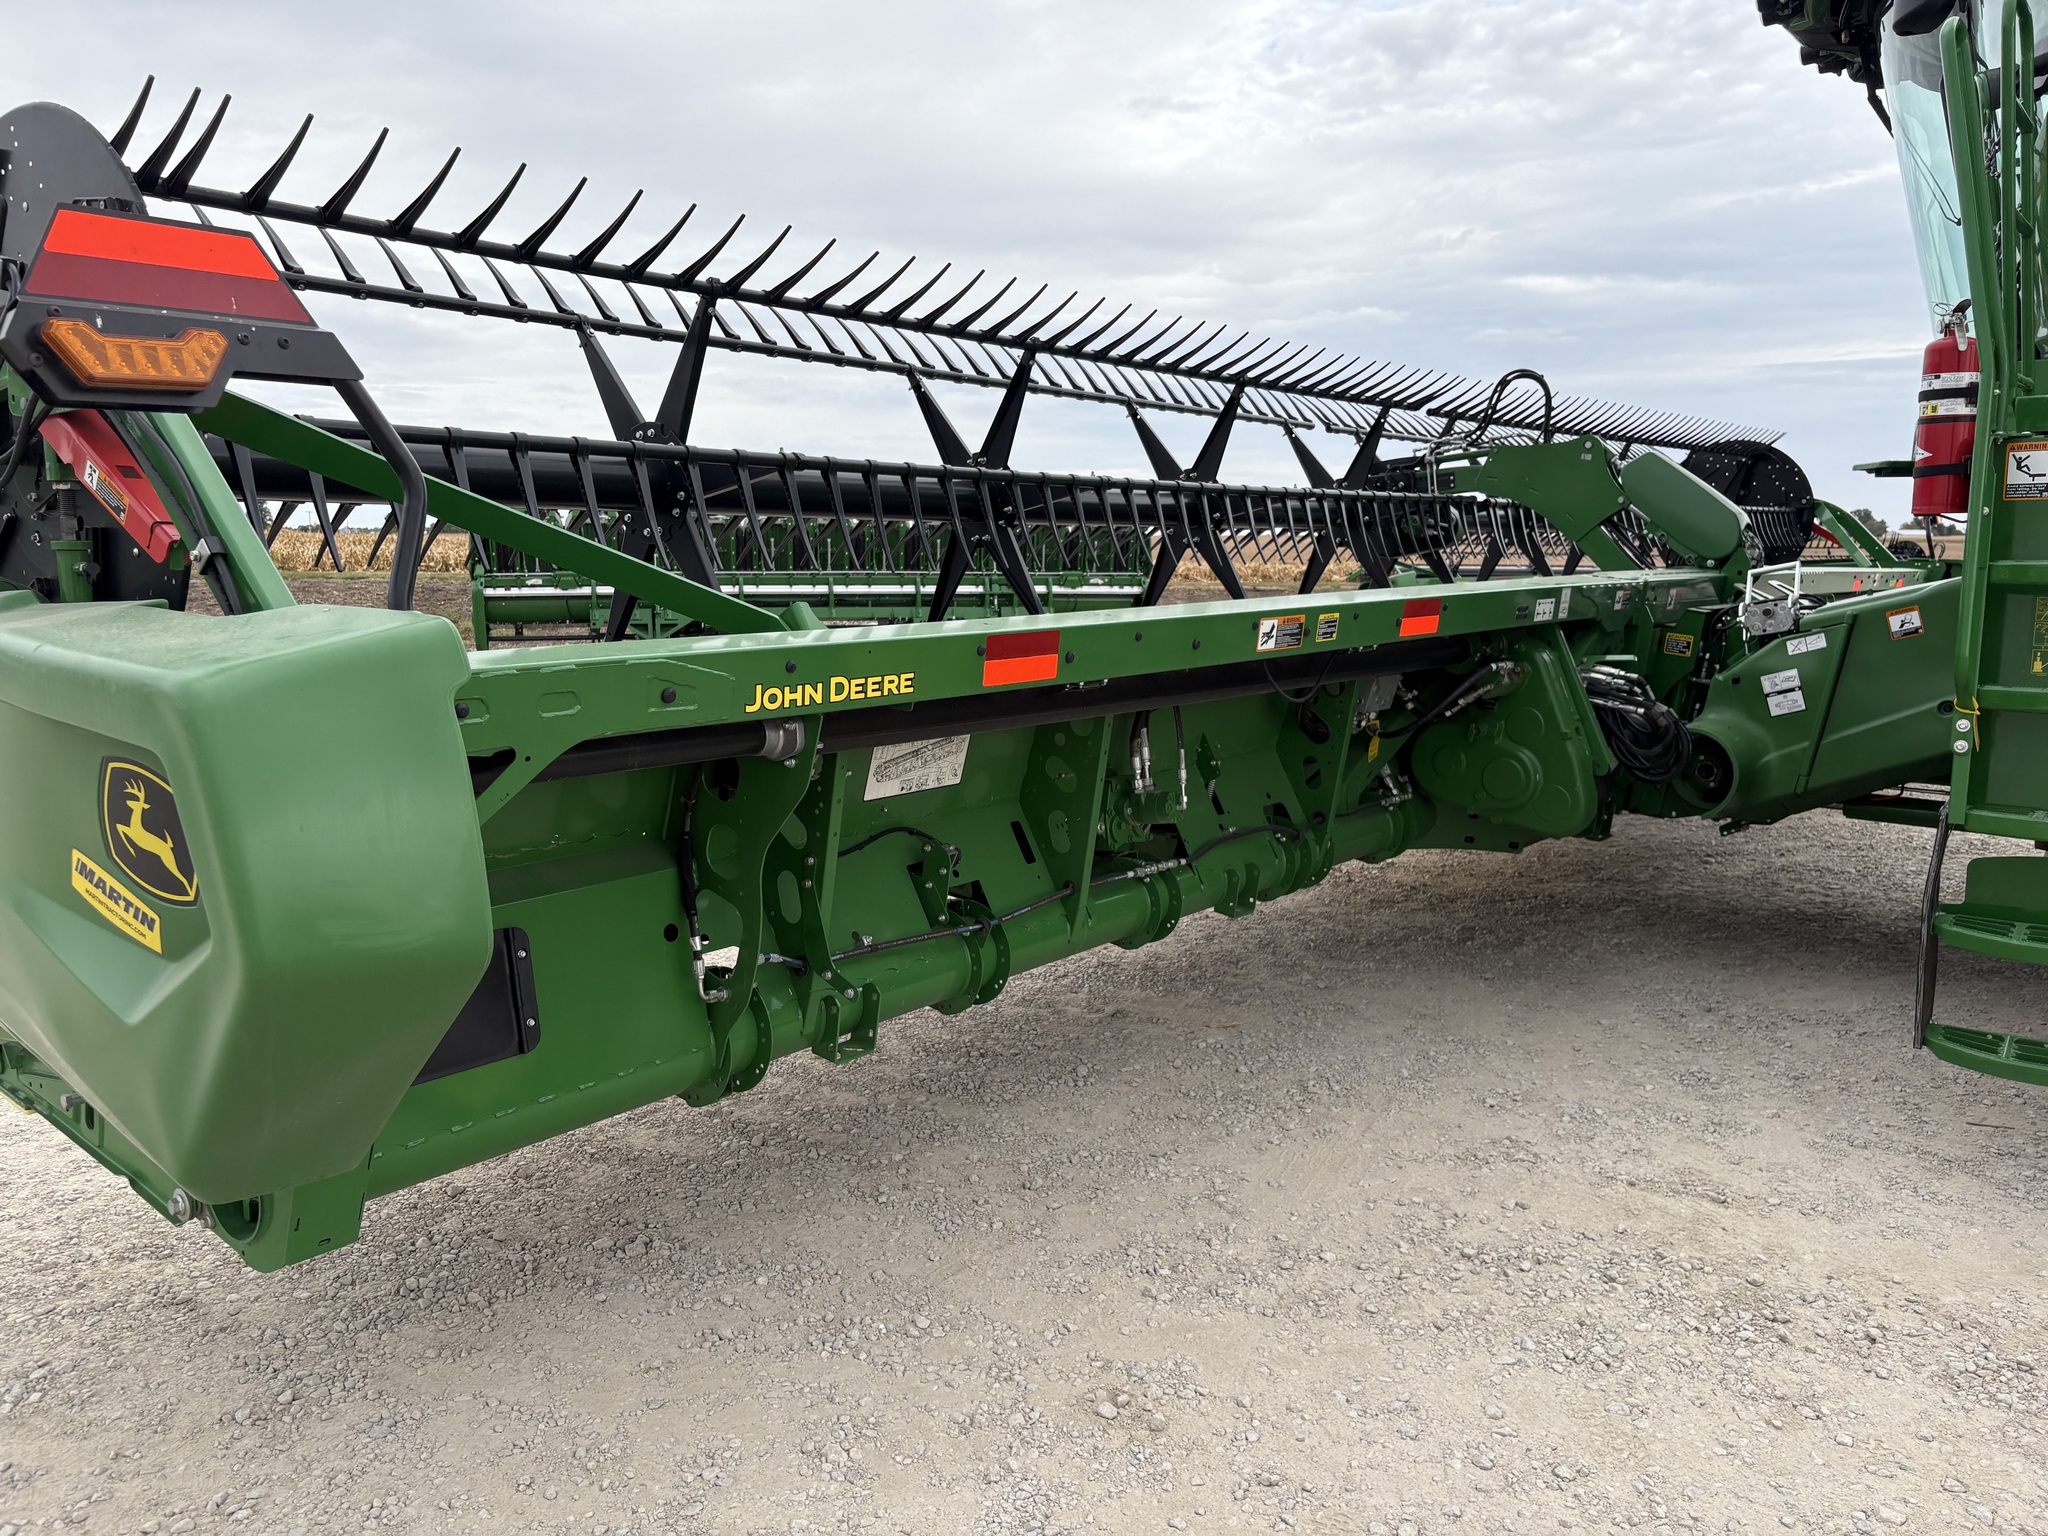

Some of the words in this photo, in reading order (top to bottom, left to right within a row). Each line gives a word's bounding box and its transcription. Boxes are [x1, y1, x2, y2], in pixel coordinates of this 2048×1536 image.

[745, 681, 823, 713] JOHN
[829, 672, 915, 703] DEERE
[75, 858, 156, 933] MARTIN
